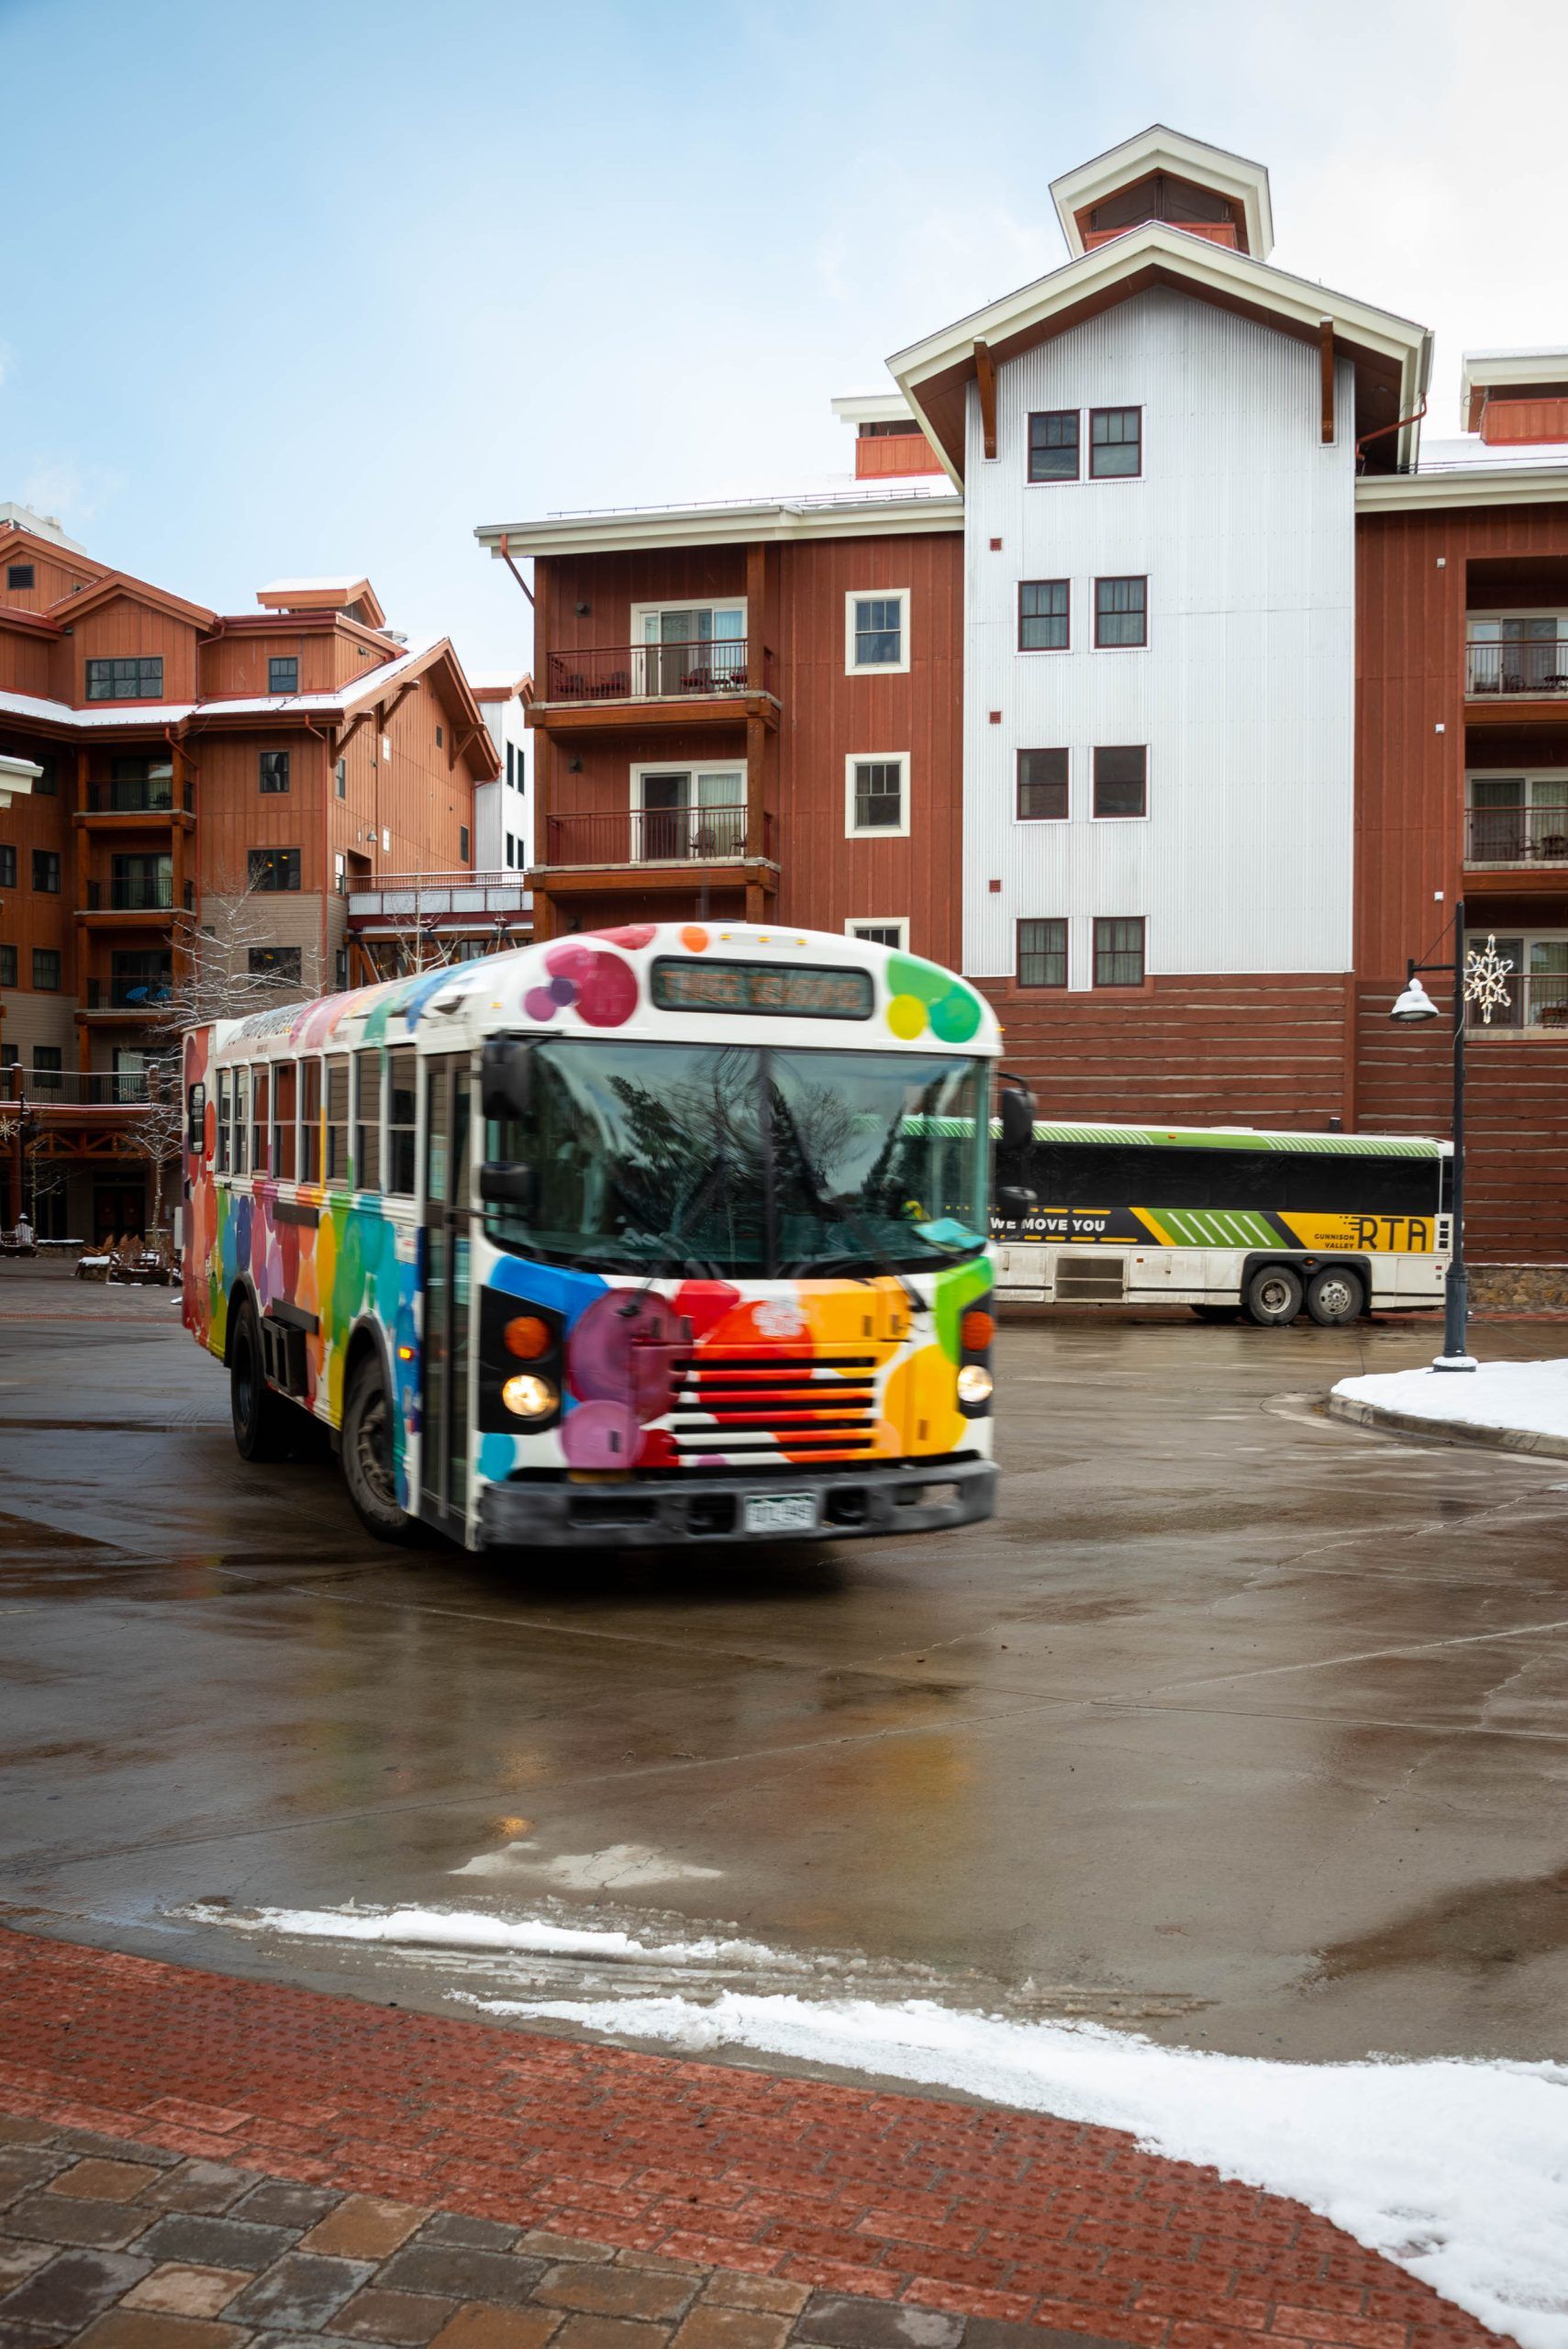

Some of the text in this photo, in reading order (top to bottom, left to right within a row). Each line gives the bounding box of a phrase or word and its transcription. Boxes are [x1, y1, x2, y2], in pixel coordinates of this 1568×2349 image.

[990, 1217, 1106, 1231] WE MOVE YOU
[1356, 1216, 1427, 1252] RTA
